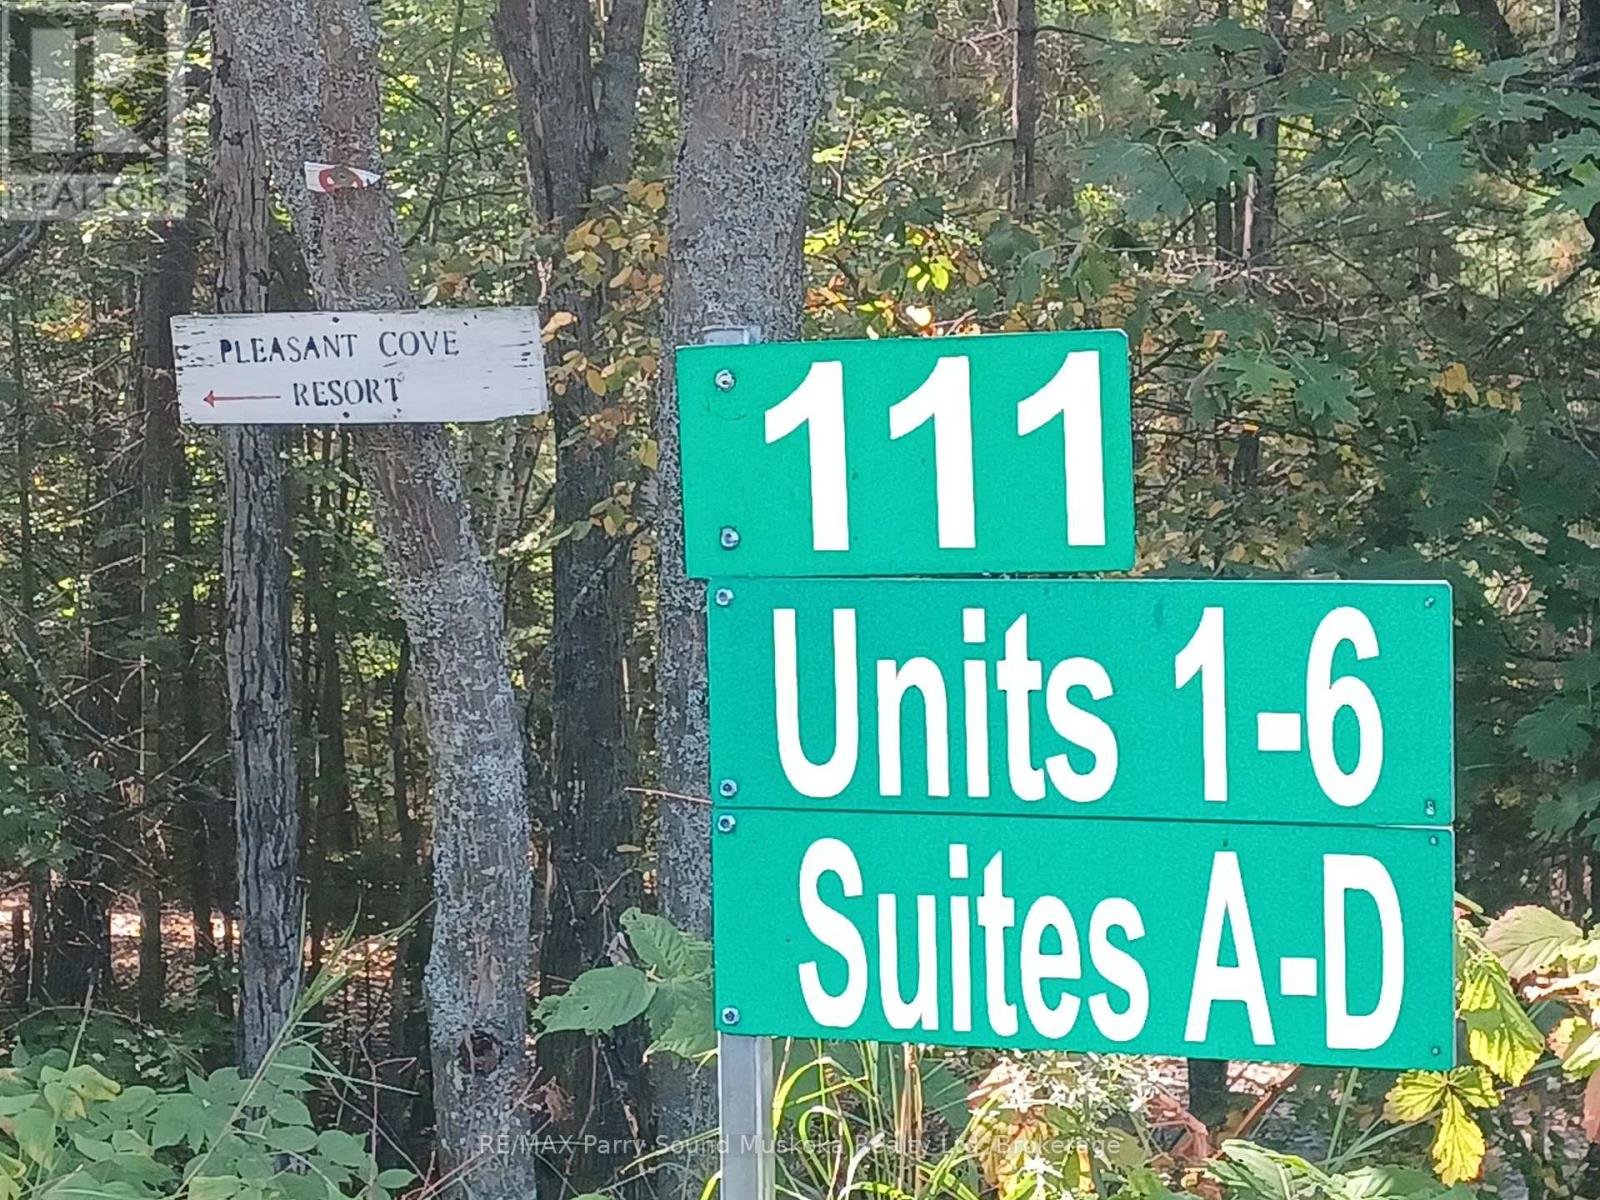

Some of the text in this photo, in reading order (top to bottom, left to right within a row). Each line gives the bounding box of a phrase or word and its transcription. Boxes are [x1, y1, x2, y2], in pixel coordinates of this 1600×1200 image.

[219, 330, 460, 363] PLEASANT COVE
[292, 377, 401, 406] RESORT
[764, 350, 1106, 552] 111
[773, 605, 1384, 808] Units 1-6
[798, 837, 1405, 1051] Suites A-D
